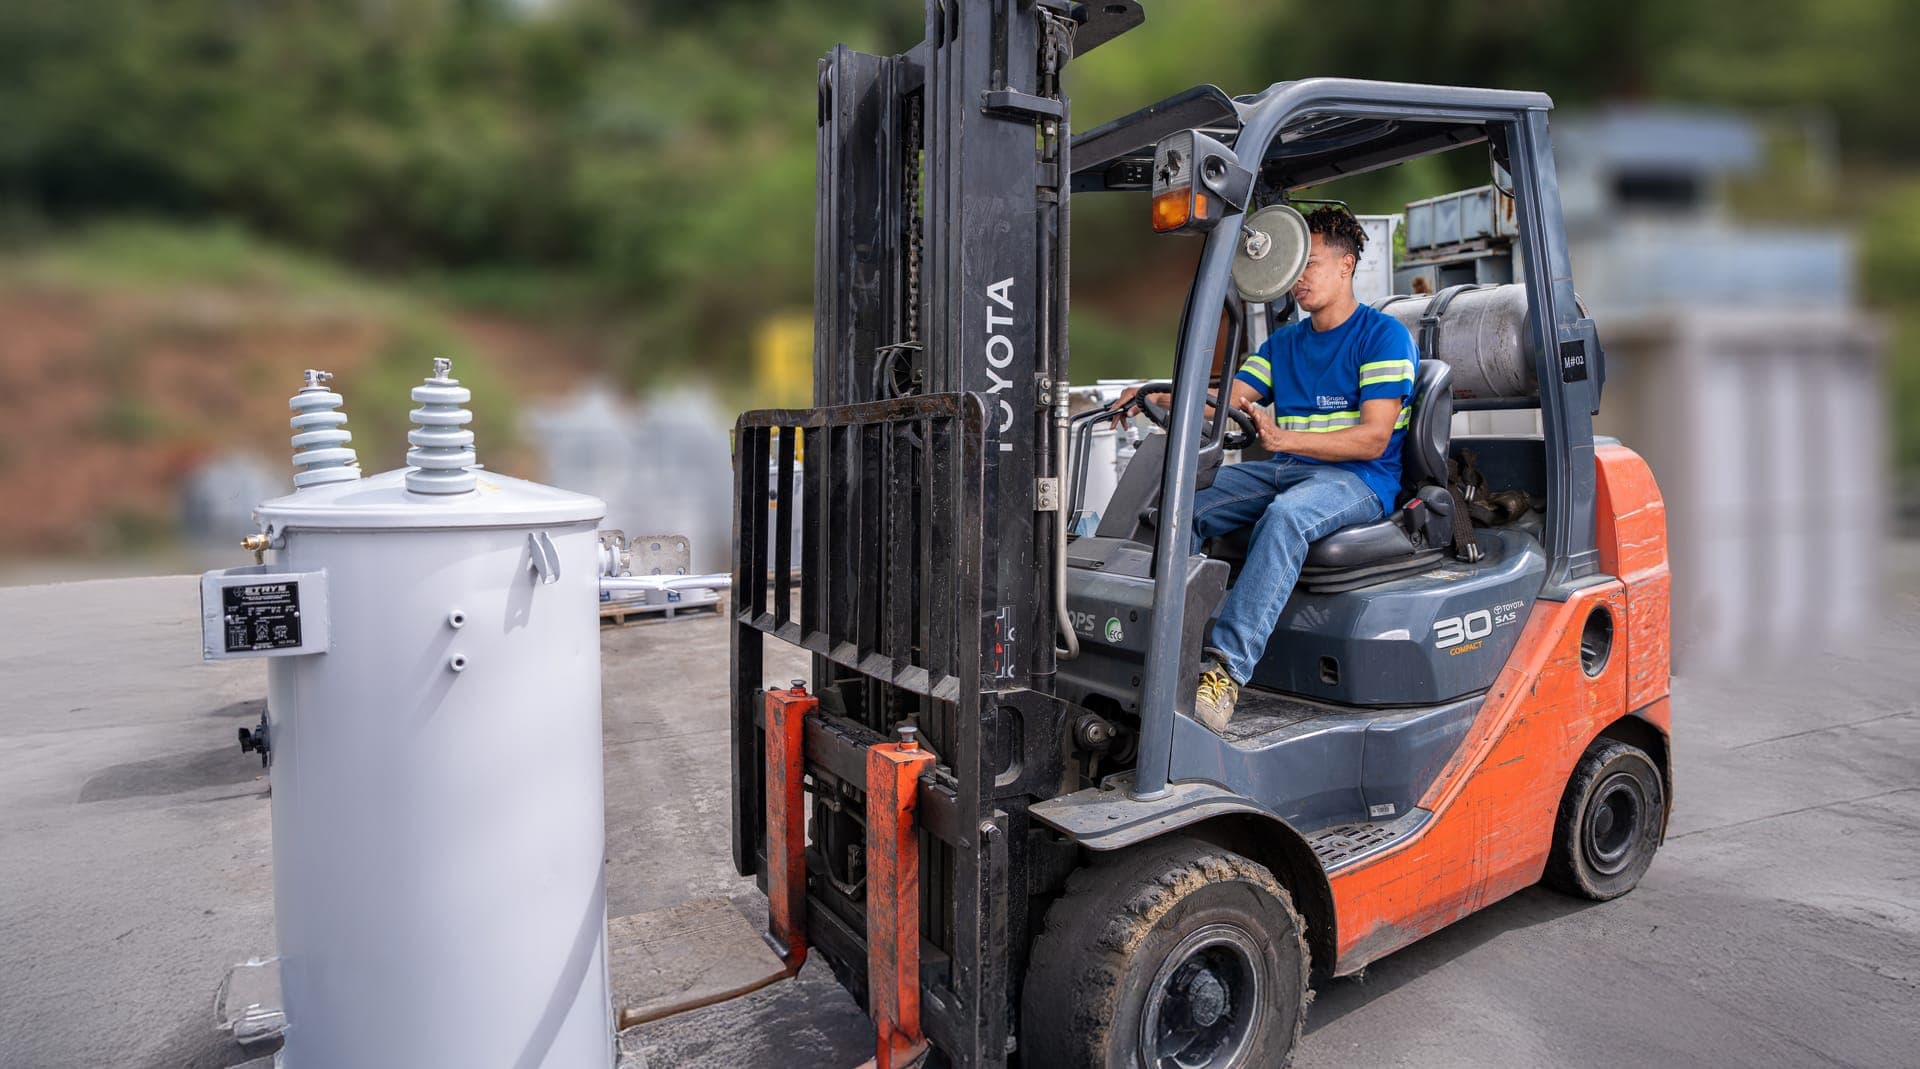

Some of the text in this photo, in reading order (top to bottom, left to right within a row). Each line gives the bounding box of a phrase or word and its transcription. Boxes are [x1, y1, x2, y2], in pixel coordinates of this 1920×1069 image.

[1502, 600, 1524, 612] TOYOTA
[1495, 611, 1516, 624] SAS
[1433, 609, 1492, 648] 30
[1449, 640, 1483, 656] COMPACT
